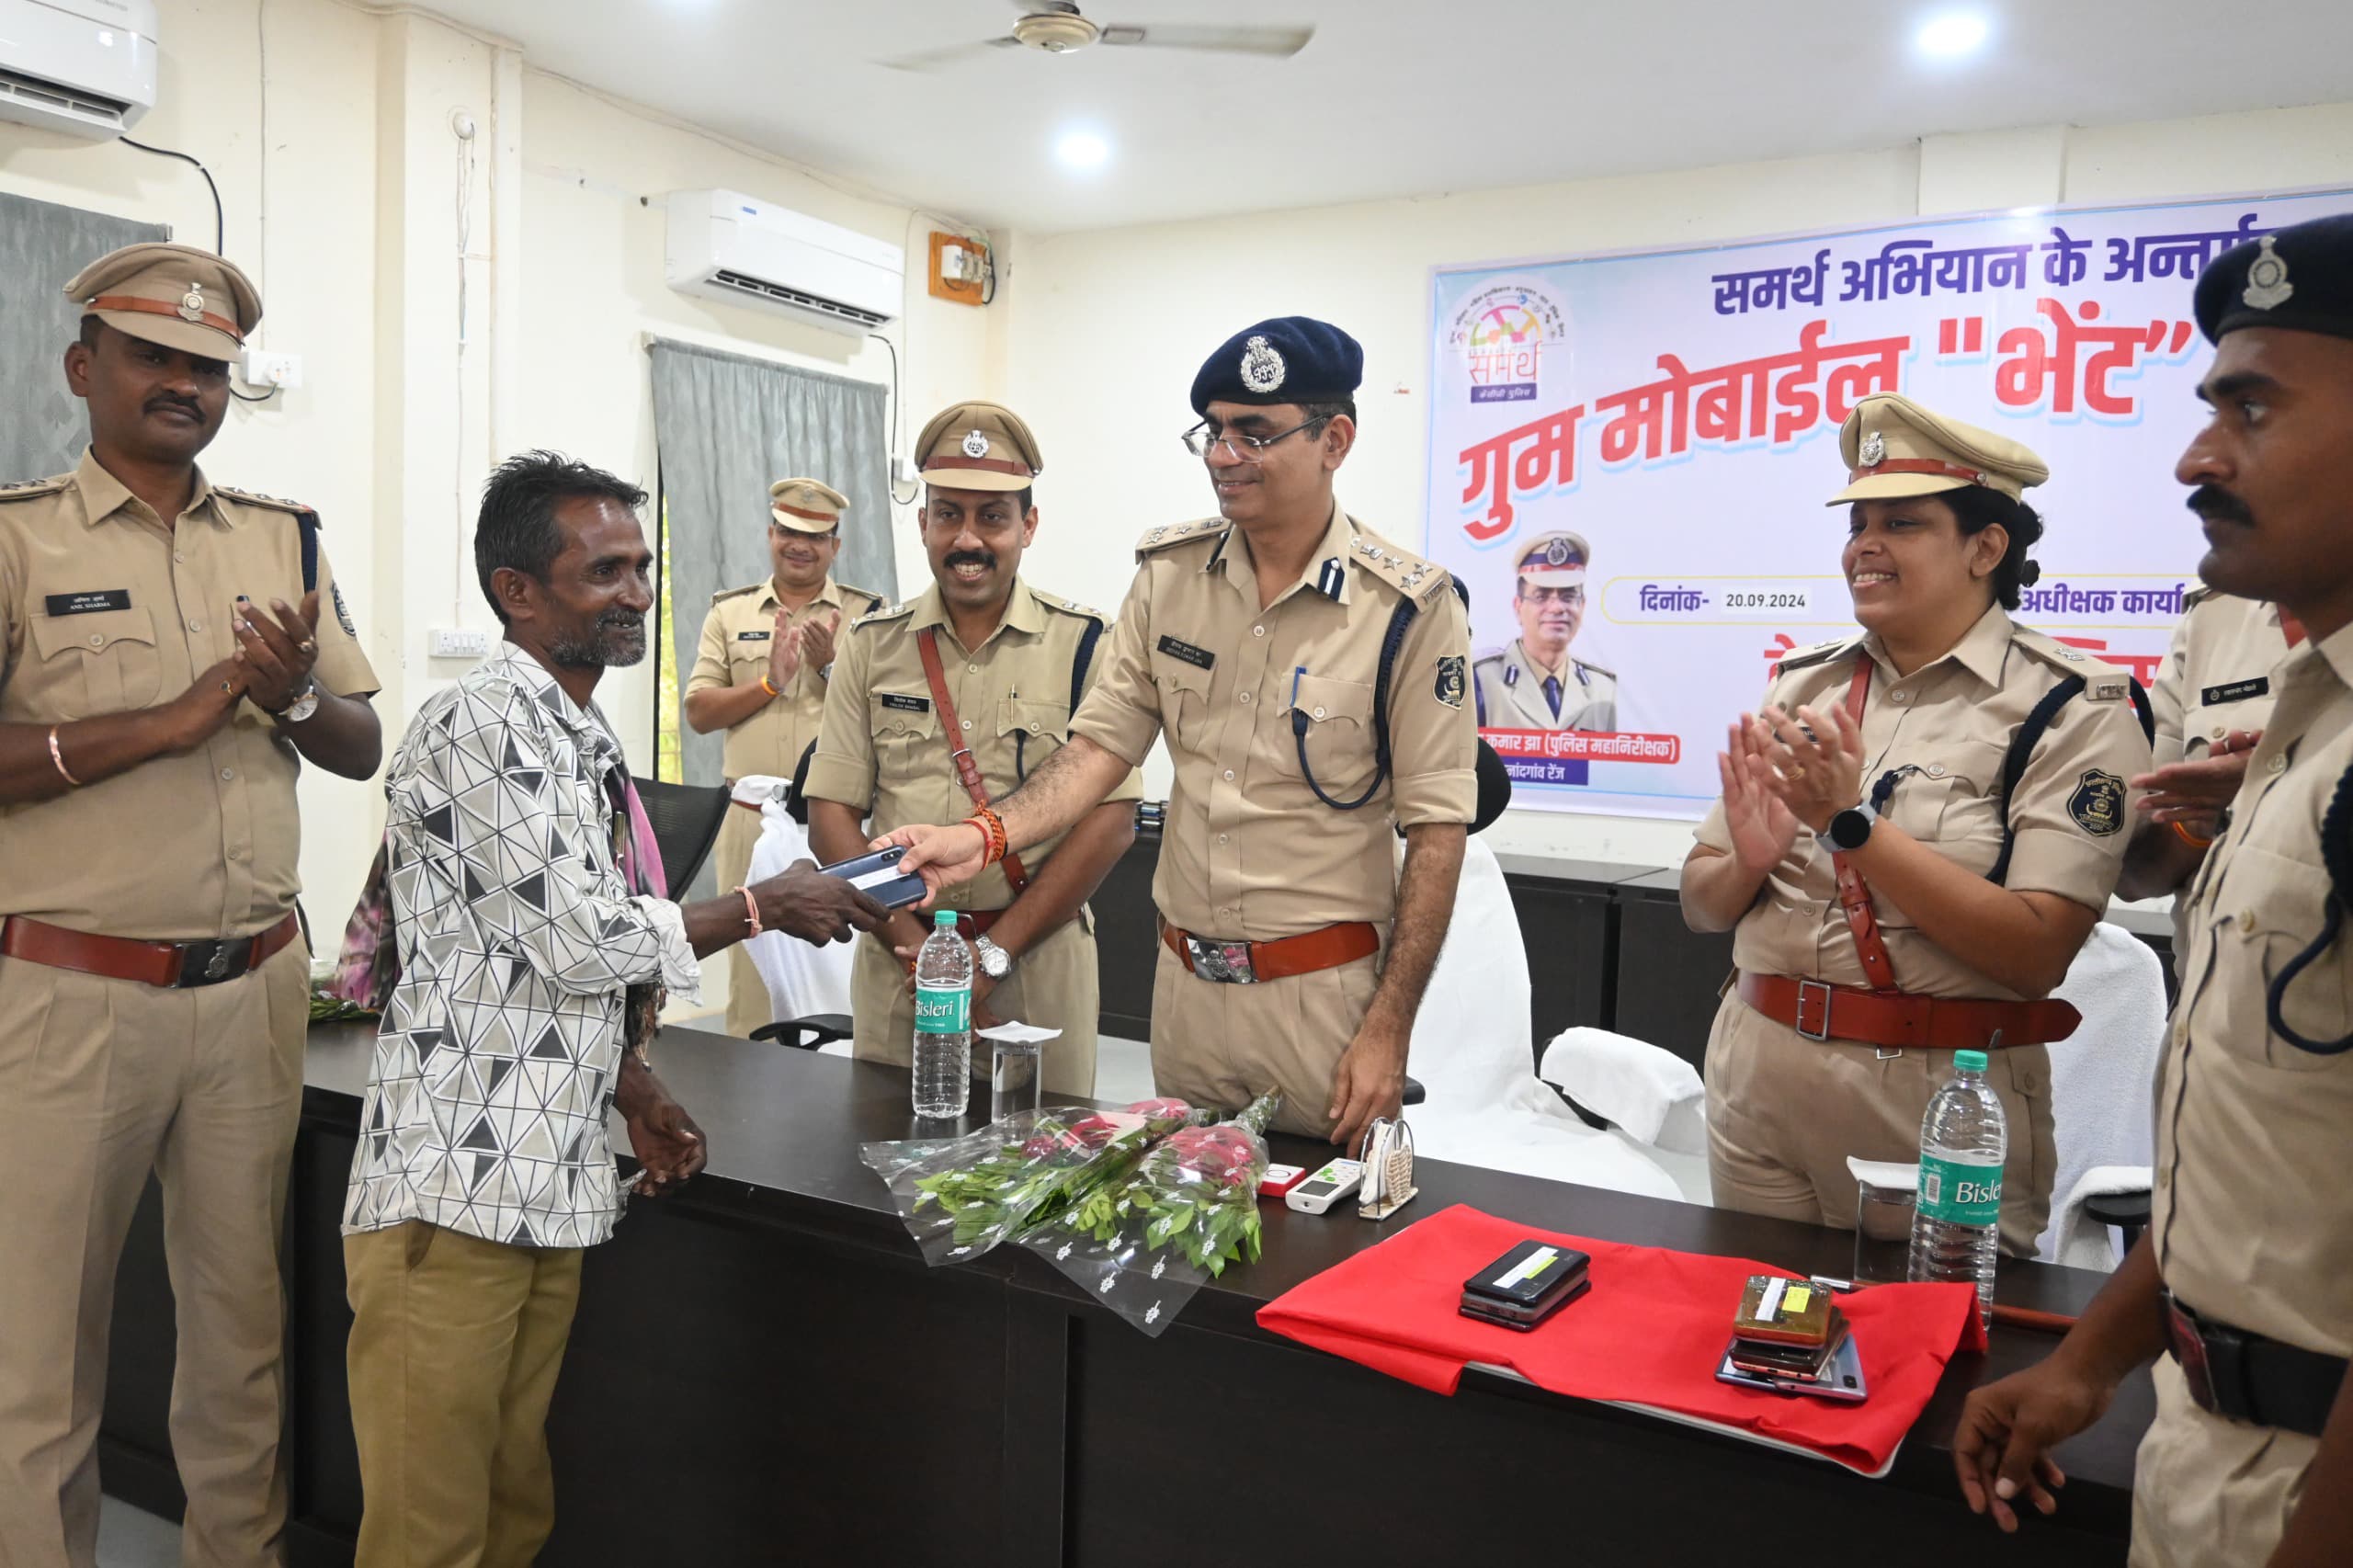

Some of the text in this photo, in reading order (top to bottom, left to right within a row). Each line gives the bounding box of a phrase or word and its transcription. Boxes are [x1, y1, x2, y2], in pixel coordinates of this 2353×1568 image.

[1712, 248, 1831, 315] समर्थ
[1839, 239, 2033, 302] अभियान
[2041, 227, 2093, 287] के
[1468, 340, 1542, 384] समर्थ
[1459, 404, 1585, 540] गुम
[1595, 319, 1910, 463] मोबाईल
[1640, 584, 1710, 611] दिनांक-
[1726, 594, 1806, 608] 20.09.2024
[2021, 582, 2118, 613] अधीक्षक
[1524, 735, 1541, 753] झा
[1590, 733, 1676, 760] महानिरीक्षक)
[1505, 763, 1545, 780] नांदगांव
